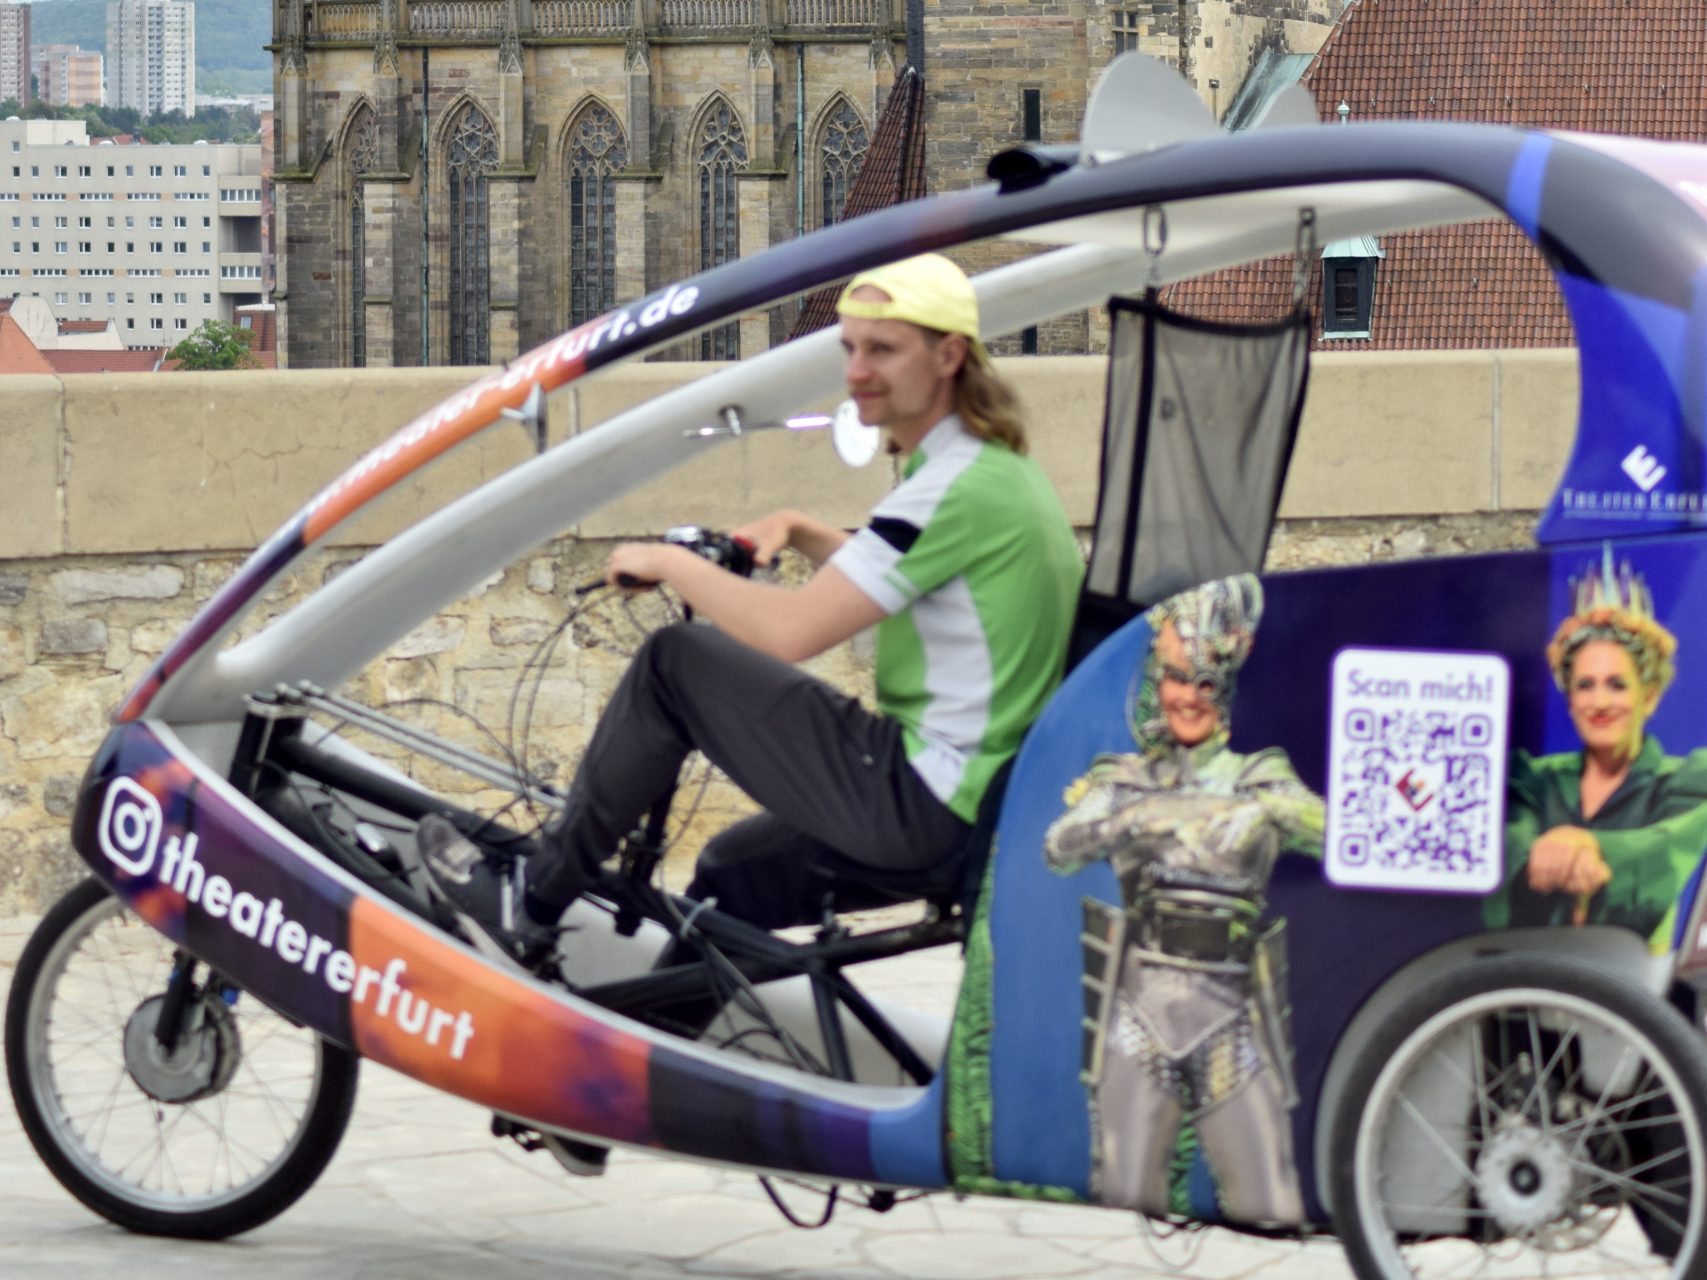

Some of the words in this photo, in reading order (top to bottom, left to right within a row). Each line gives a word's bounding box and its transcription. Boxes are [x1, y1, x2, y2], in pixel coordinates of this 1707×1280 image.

[1347, 669, 1411, 698] Scan
[1420, 672, 1494, 702] mich!
[160, 832, 474, 1060] theatererfurt
